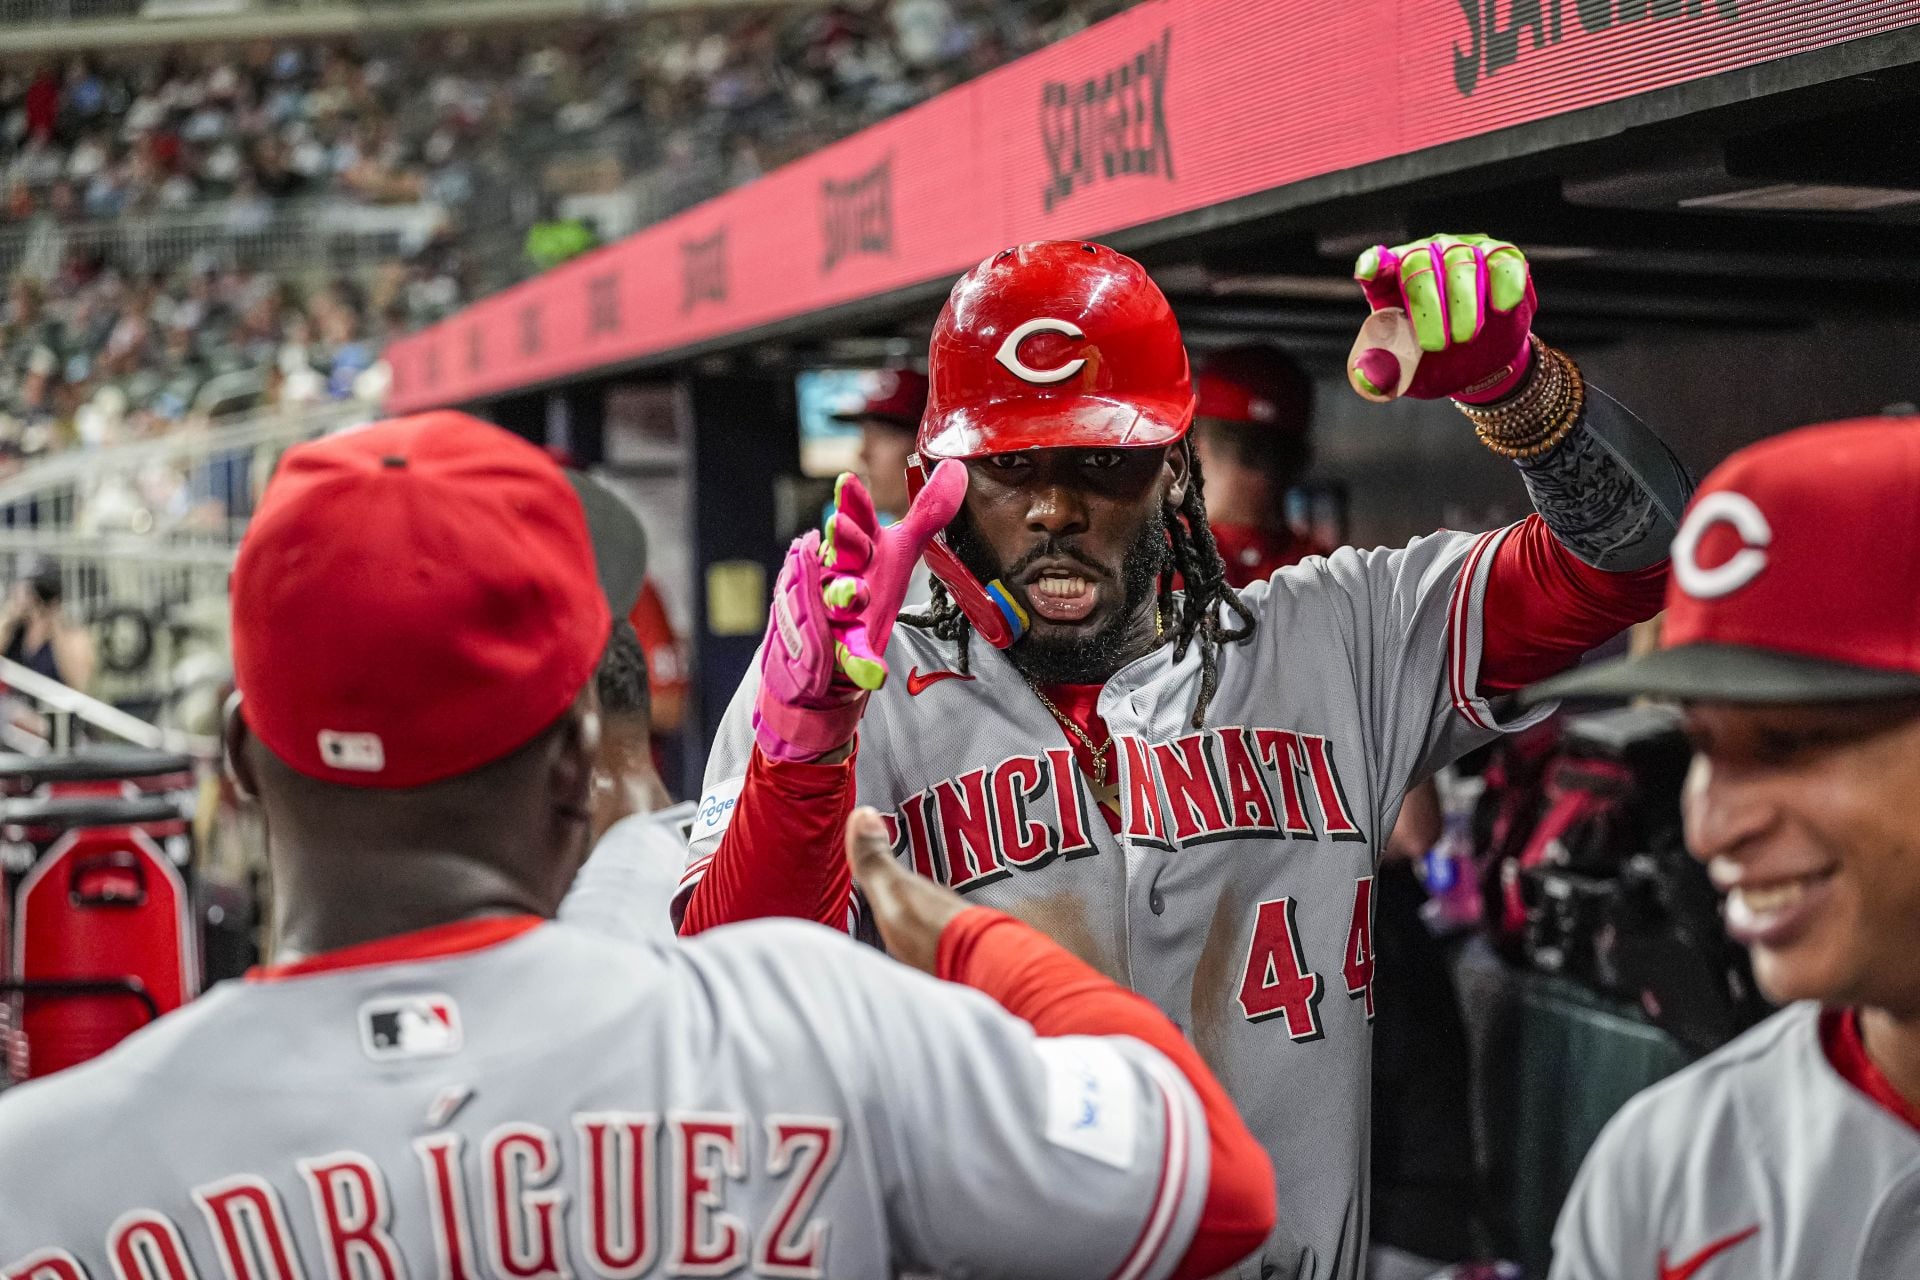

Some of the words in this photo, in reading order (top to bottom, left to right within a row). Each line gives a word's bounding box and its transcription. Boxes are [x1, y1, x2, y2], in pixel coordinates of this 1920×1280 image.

[994, 316, 1088, 388] C
[1670, 490, 1771, 600] C
[696, 795, 738, 827] roge
[1236, 876, 1376, 1044] 44
